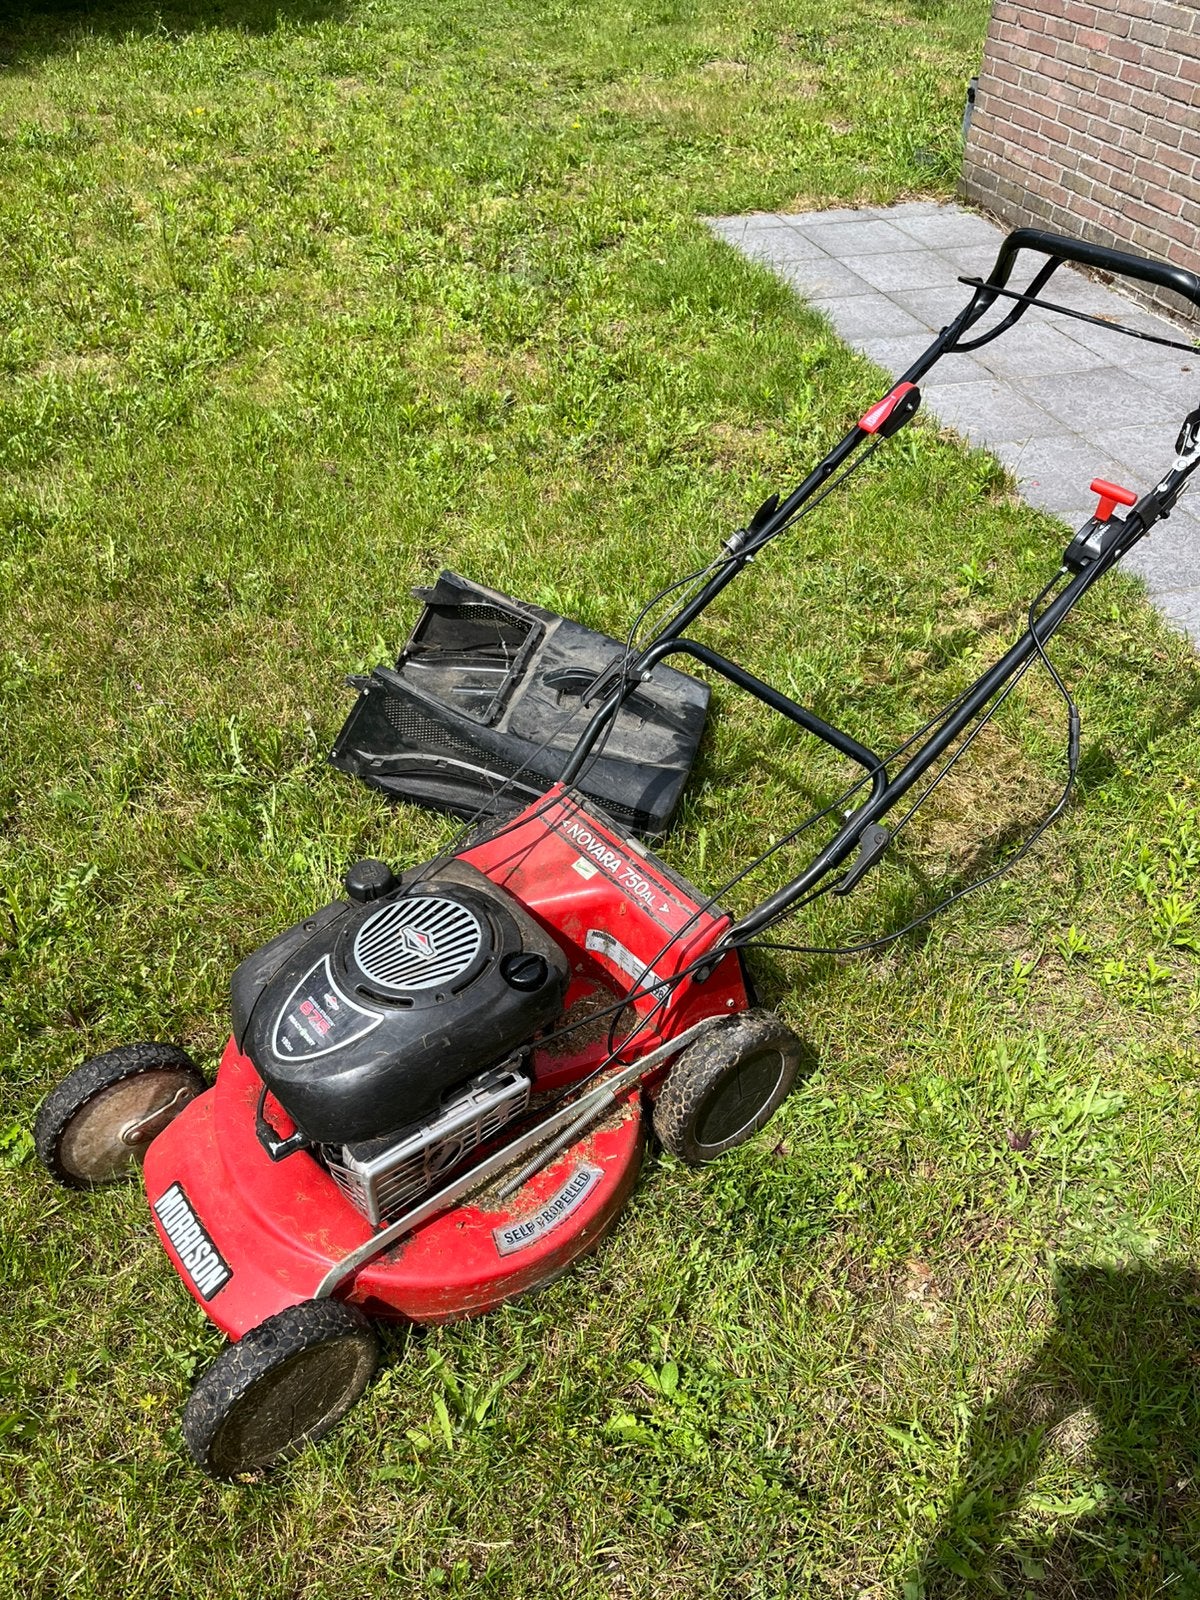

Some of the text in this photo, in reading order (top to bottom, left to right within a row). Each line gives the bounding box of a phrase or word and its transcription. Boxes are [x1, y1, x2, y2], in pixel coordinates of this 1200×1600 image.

[566, 823, 622, 873] NOVARA
[618, 867, 656, 907] 750AL
[300, 1001, 331, 1034] 675
[153, 1185, 228, 1295] MORRISON
[504, 1169, 591, 1245] SELF PROPELLED
